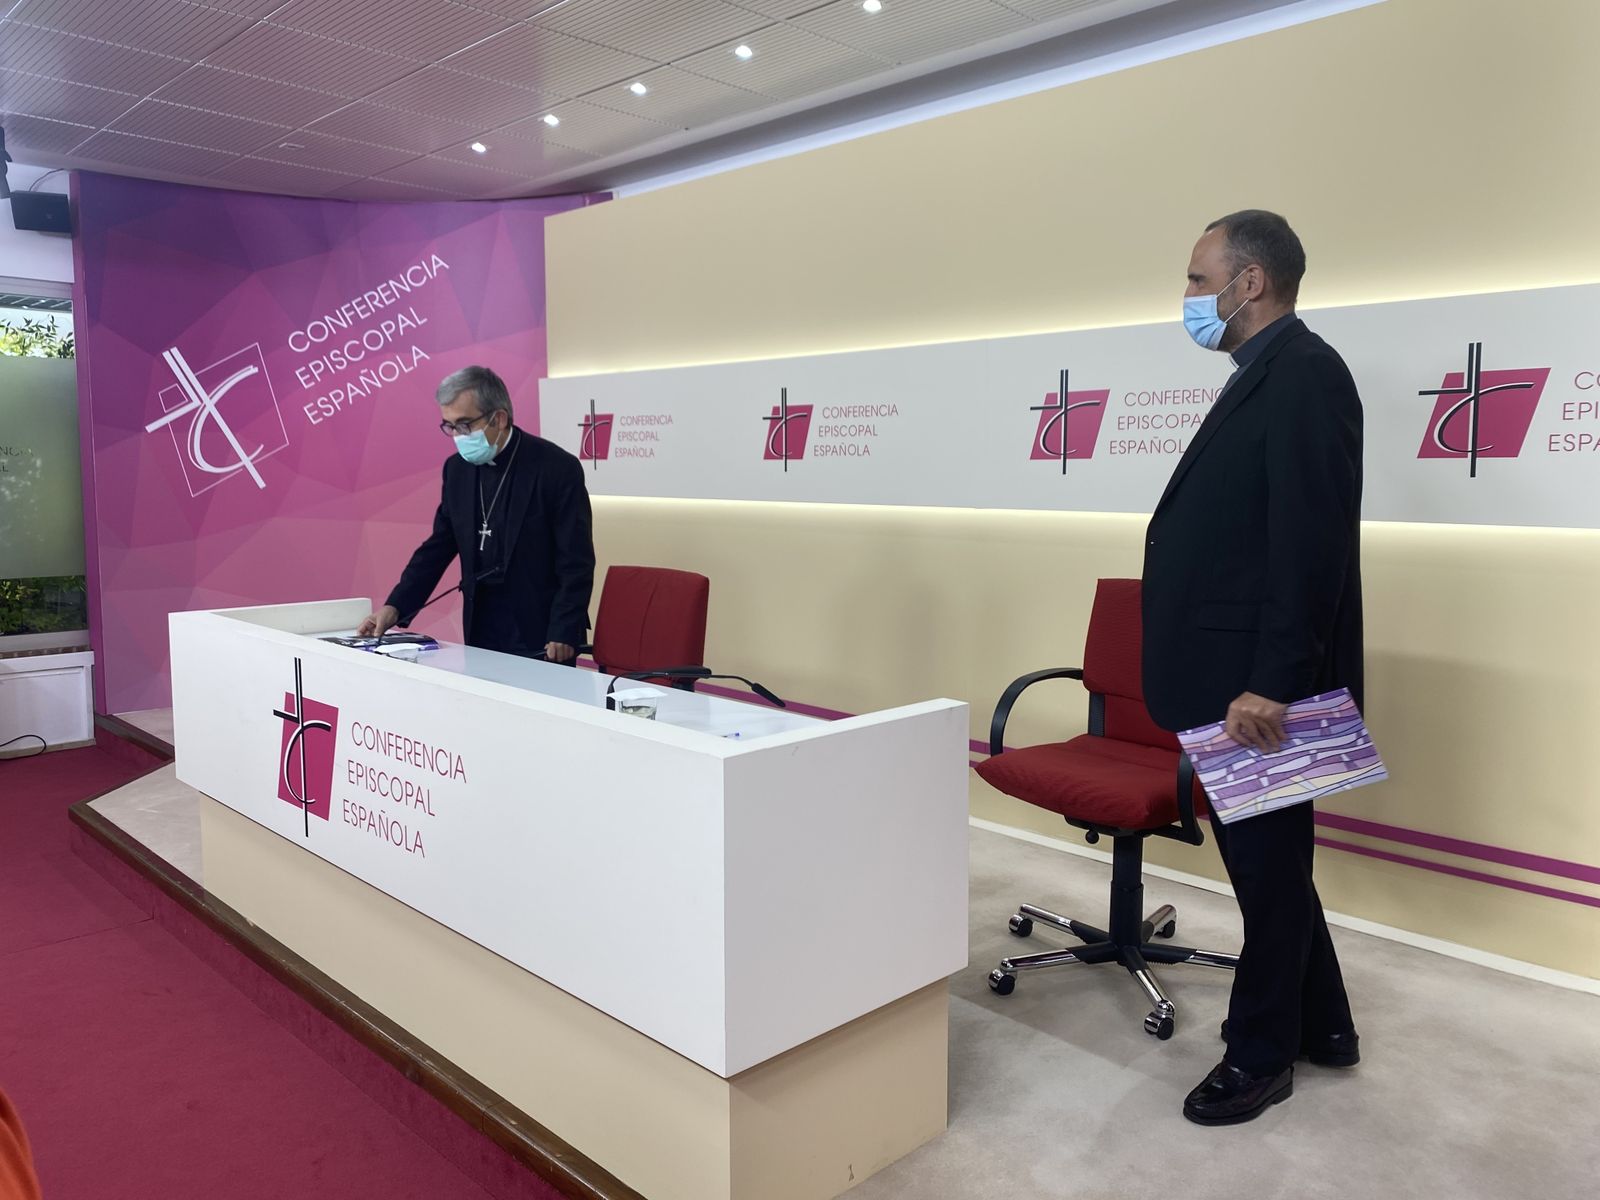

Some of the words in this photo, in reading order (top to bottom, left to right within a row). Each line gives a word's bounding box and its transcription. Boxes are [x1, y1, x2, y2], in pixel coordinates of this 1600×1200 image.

[288, 254, 450, 353] CONFERENCIA
[295, 306, 428, 389] EPISCOPAL
[303, 345, 431, 425] ESPAÑOLA
[1574, 371, 1600, 390] C
[620, 414, 673, 426] CONFERENCIA
[822, 403, 899, 419] CONFERENCIA
[1562, 401, 1600, 420] EPI
[617, 431, 660, 442] EPISCOPAL
[818, 424, 878, 437] EPISCOPAL
[614, 446, 655, 458] ESPAÑOLA
[813, 441, 871, 457] ESPAÑOLA
[351, 721, 467, 784] CONFERENCIA
[347, 759, 436, 817] EPISCOPAL
[342, 798, 425, 858] ESPAÑOLA
